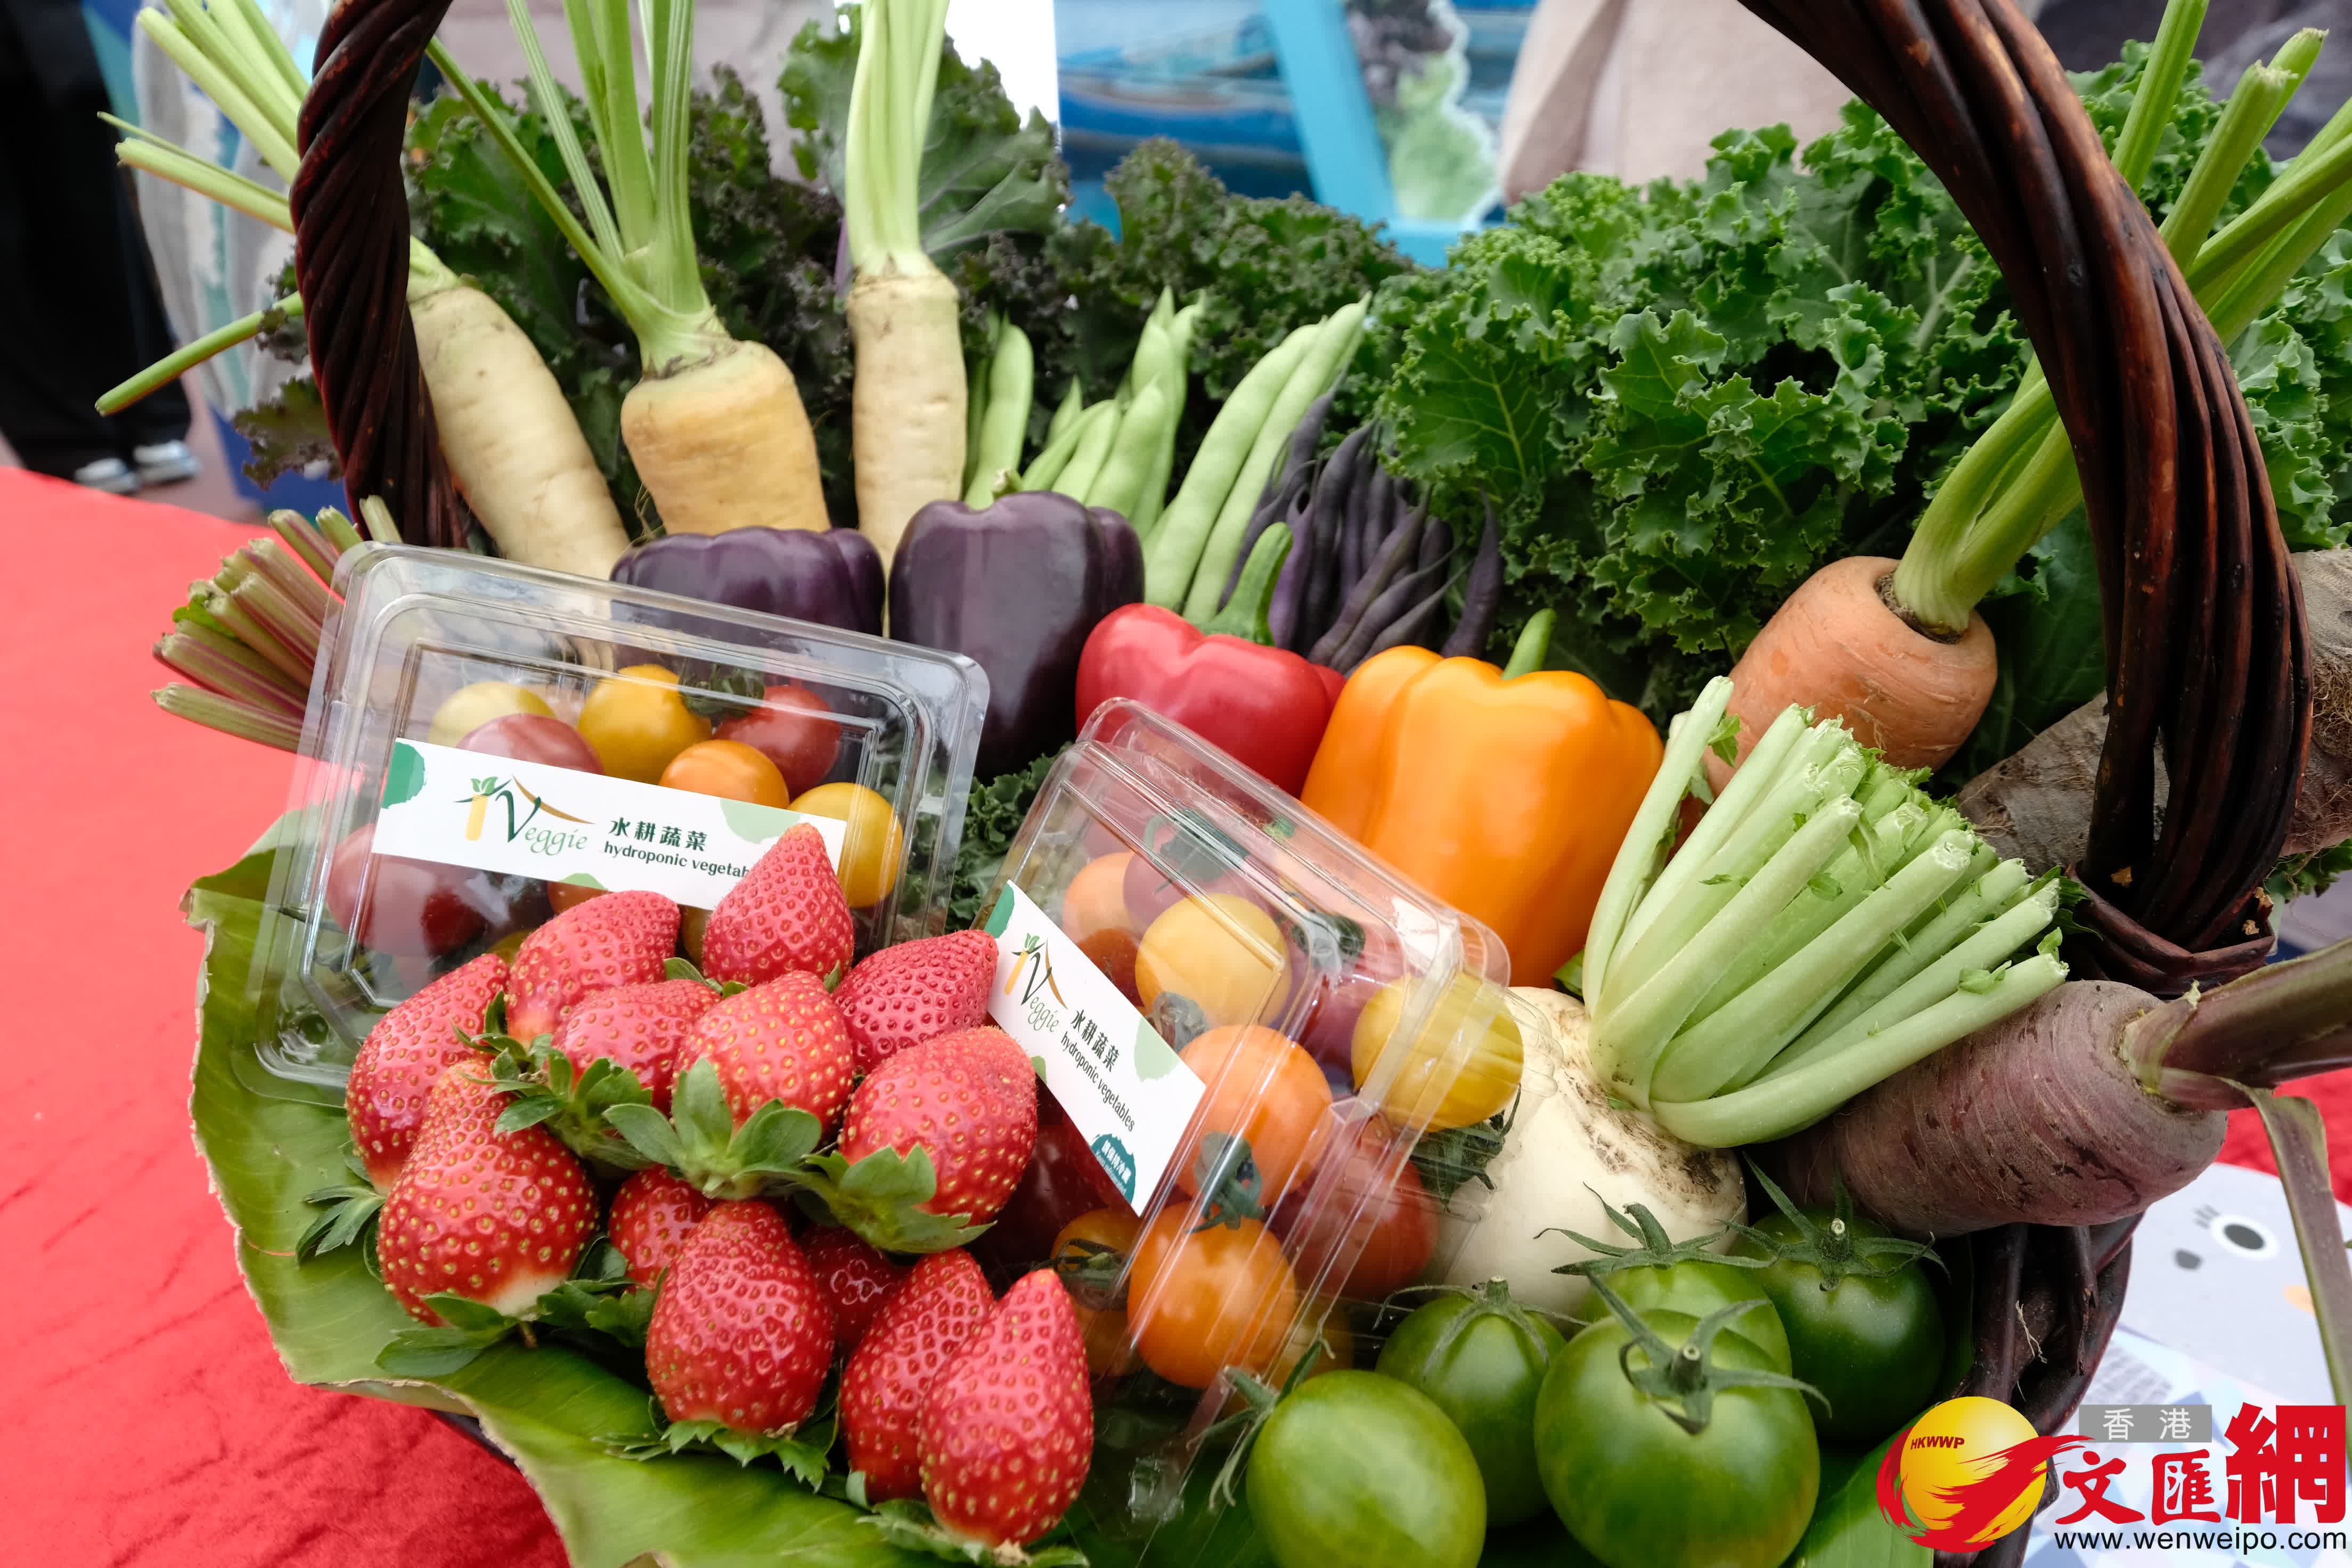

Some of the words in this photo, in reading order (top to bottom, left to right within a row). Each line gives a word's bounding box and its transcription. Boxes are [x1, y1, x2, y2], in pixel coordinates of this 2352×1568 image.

[608, 817, 708, 852] 水耕蔬菜
[604, 841, 688, 867] hydroponic
[692, 859, 749, 878] vegetab
[1070, 1010, 1120, 1072] 水耕蔬菜
[1060, 1031, 1099, 1083] hydroponic
[1097, 1078, 1135, 1132] vegetables
